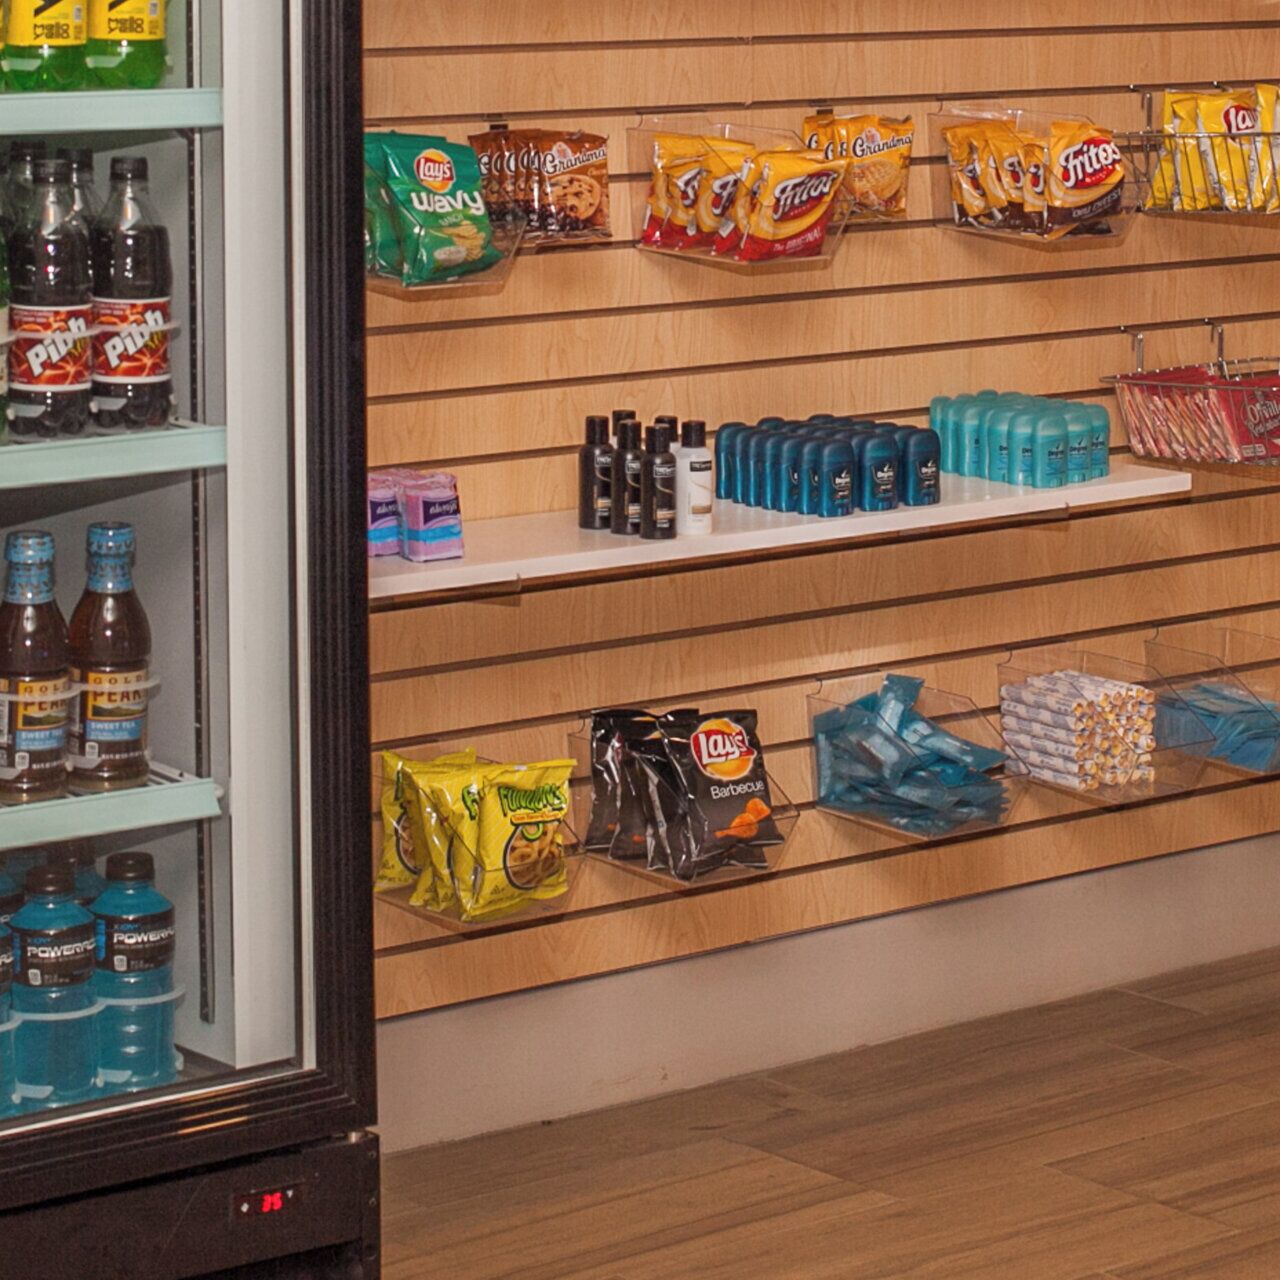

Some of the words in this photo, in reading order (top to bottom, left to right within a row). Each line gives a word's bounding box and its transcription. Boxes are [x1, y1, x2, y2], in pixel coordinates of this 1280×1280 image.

[419, 159, 452, 182] Lay's
[1059, 141, 1120, 188] Fritos
[772, 170, 838, 220] Fritos
[26, 316, 88, 377] Pibb
[103, 309, 164, 369] Pibb
[93, 675, 143, 686] GOLD
[698, 730, 748, 764] Lay's
[710, 779, 765, 800] Barbecue
